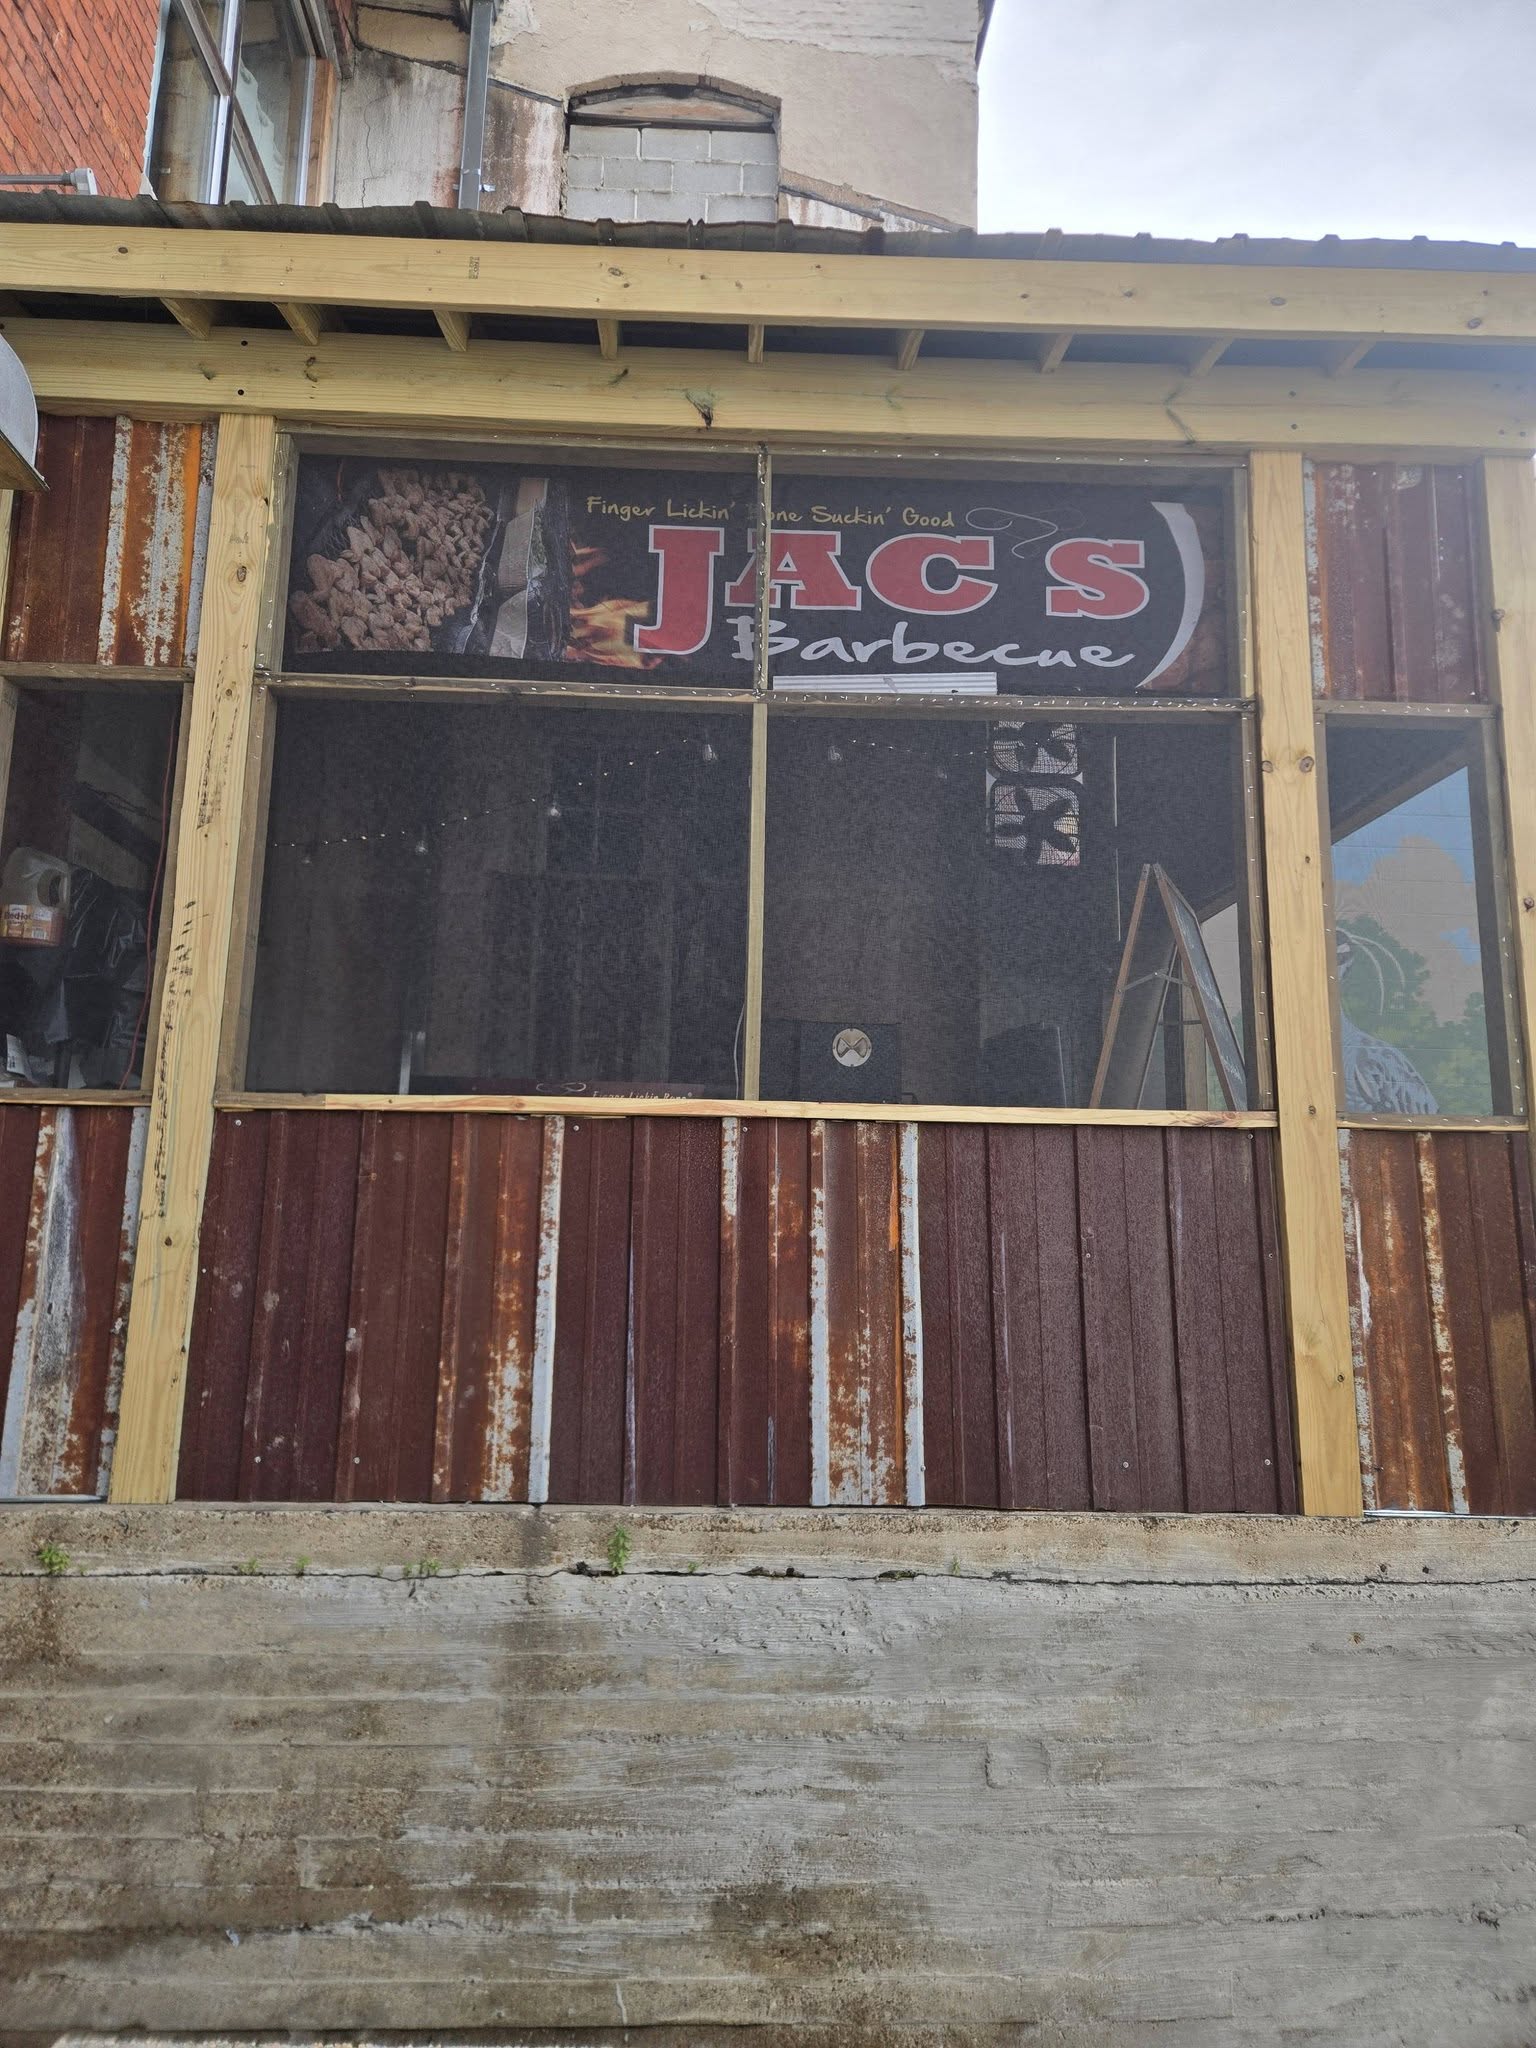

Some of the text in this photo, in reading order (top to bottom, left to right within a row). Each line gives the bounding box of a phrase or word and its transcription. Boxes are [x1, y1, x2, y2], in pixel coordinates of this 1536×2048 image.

[586, 496, 656, 521] Finger
[666, 499, 736, 521] Lickin'
[811, 505, 892, 526] Suckin'
[902, 507, 955, 528] Good
[726, 615, 1136, 668] Barbecue
